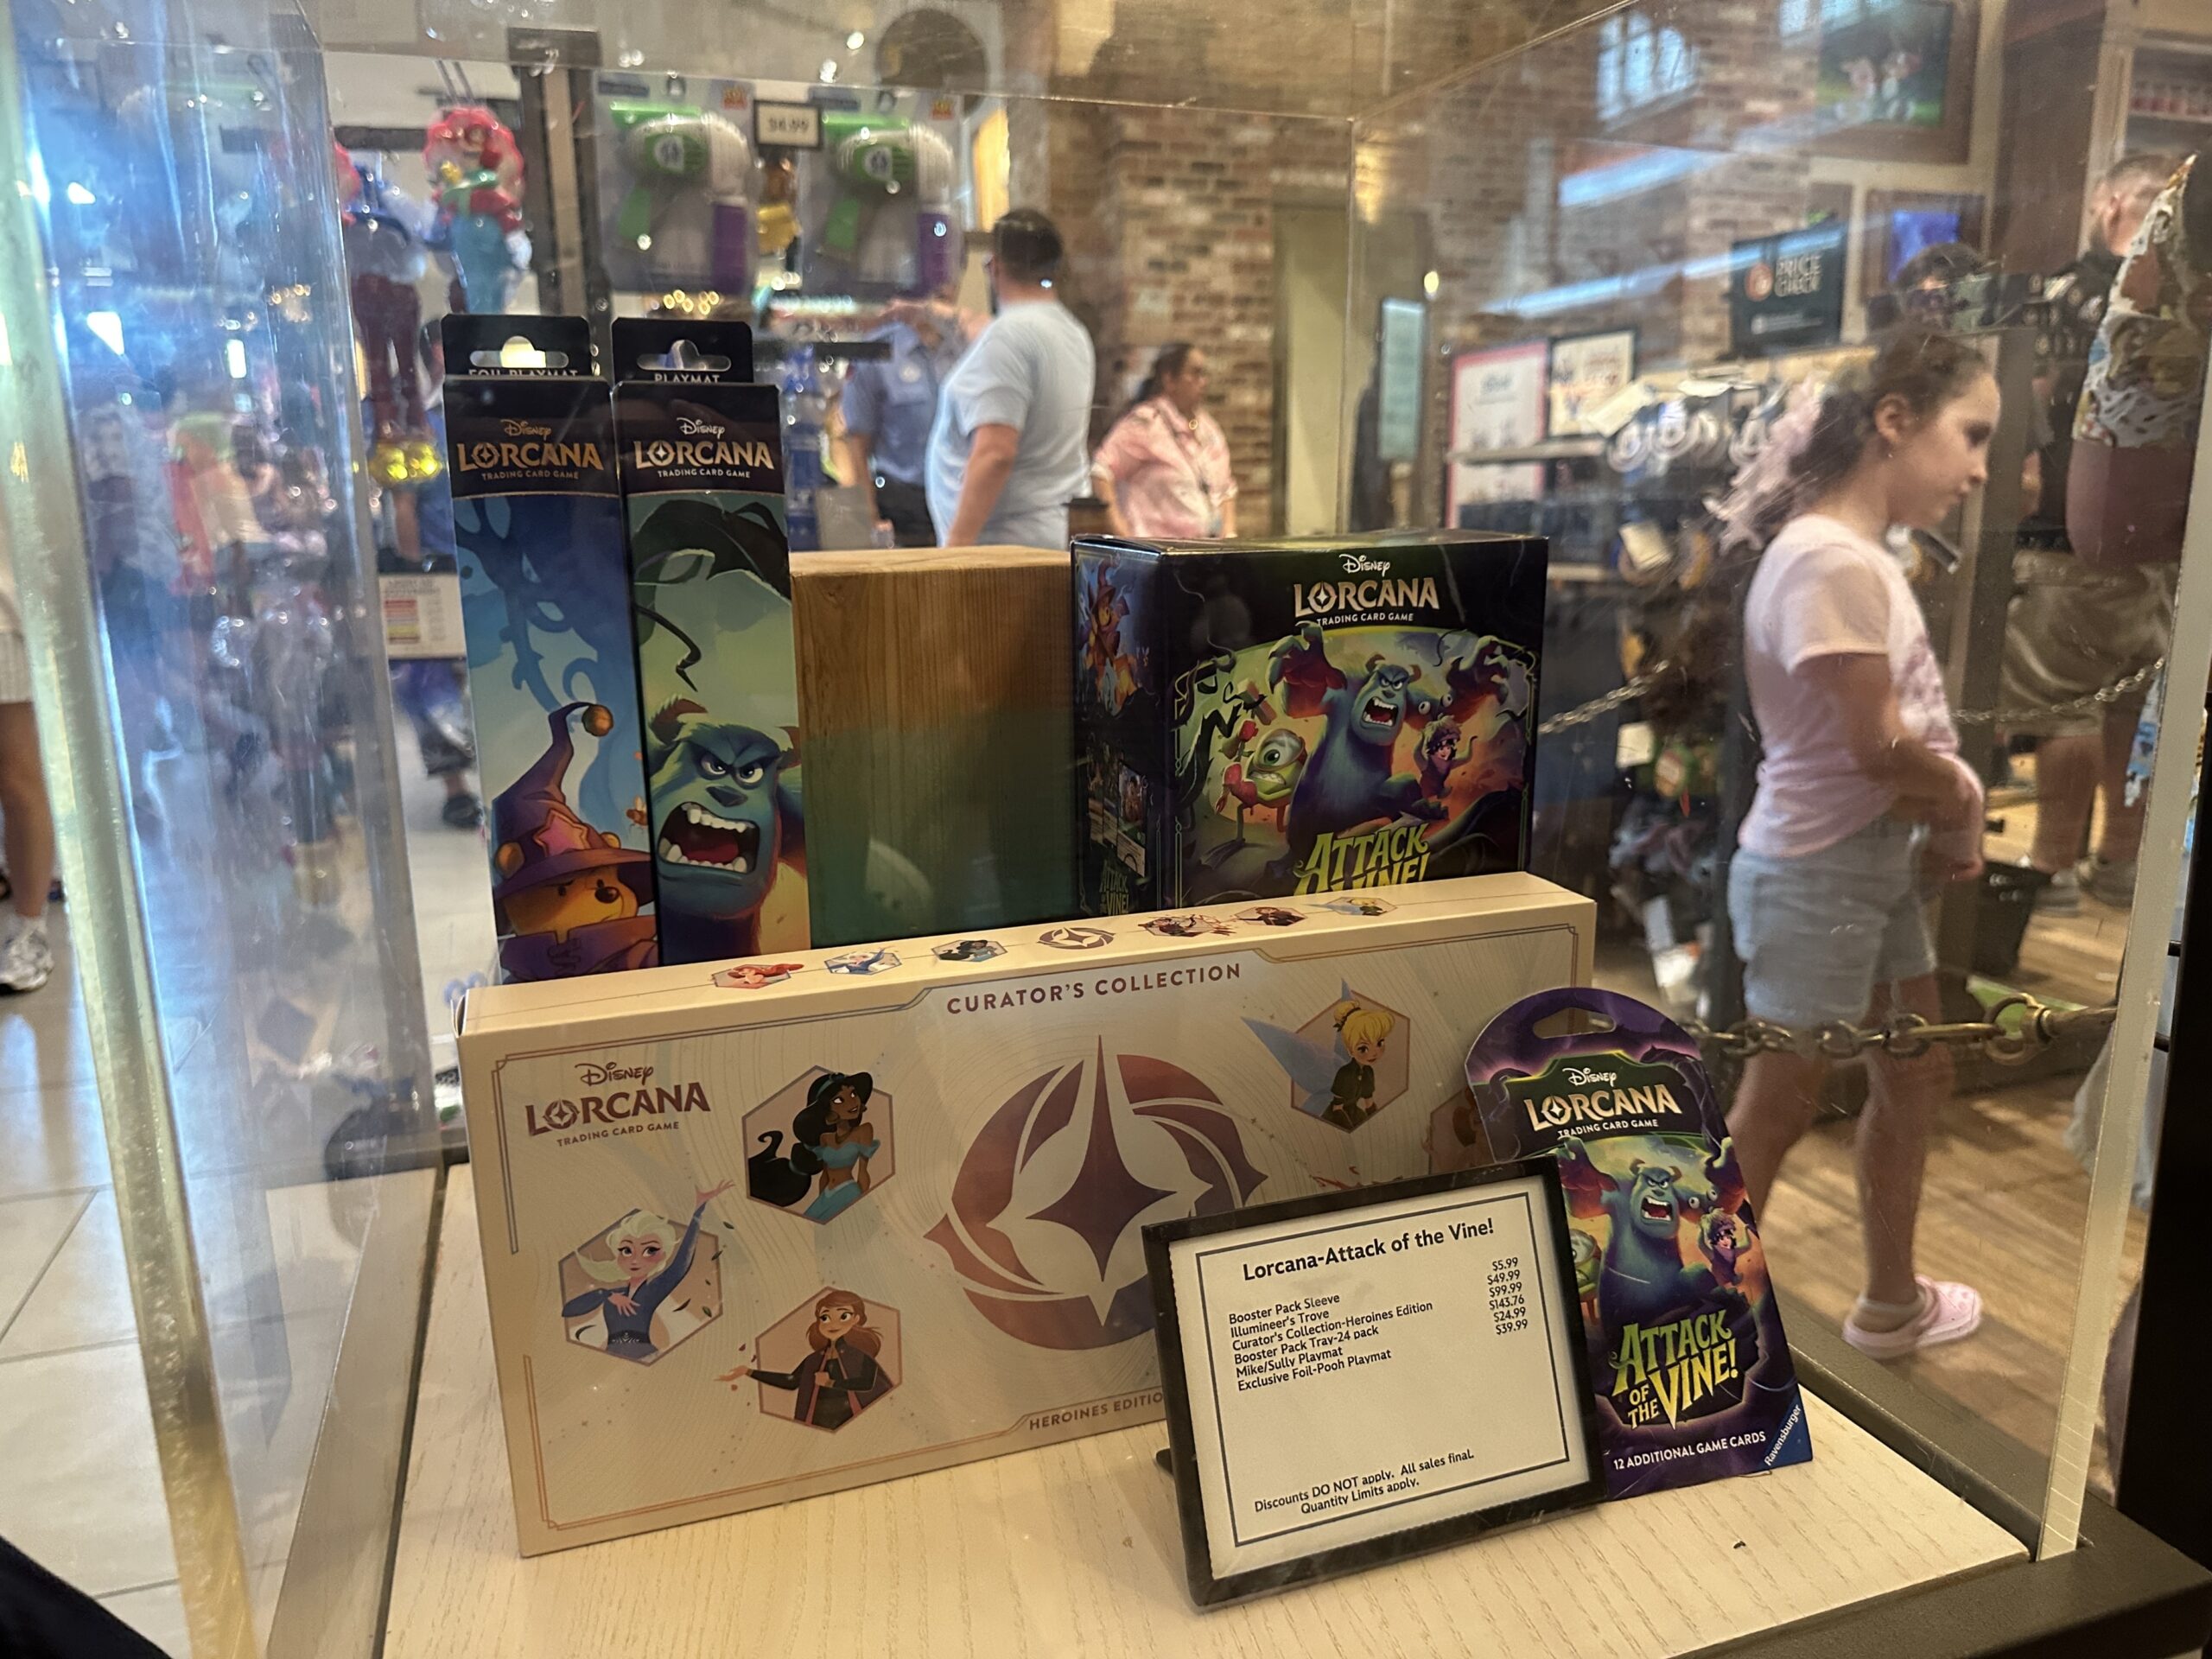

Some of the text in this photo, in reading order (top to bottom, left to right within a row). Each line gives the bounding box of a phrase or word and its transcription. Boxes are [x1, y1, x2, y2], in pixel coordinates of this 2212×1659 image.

[654, 373, 720, 383] PLAYMAT
[500, 418, 552, 441] Disney
[677, 417, 725, 439] Disney
[456, 442, 604, 472] LORCANA
[633, 441, 774, 470] LORCANA
[482, 470, 523, 481] TRADING
[553, 470, 579, 480] GAME
[658, 468, 750, 478] TRADING CARD GAME
[1339, 554, 1391, 576] Disney
[1294, 577, 1440, 618] LORCANA
[1317, 612, 1414, 626] TRADING CARD GAME
[1293, 823, 1430, 896] ATTACK
[946, 963, 1241, 1015] CURATOR'S COLLECTION
[574, 1062, 654, 1086] Disney
[1562, 1067, 1618, 1087] Disney
[525, 1082, 711, 1137] LORCANA
[1523, 1084, 1682, 1132] LORCANA
[556, 1122, 679, 1147] TRADING CARD GAME
[1557, 1119, 1659, 1138] TRADING CARD GAME
[1243, 1217, 1494, 1281] Lorcana-Attack of the Vine!
[1487, 1269, 1521, 1285] $49.99
[1491, 1257, 1518, 1271] $5.99
[1489, 1281, 1522, 1298] $99.99
[1489, 1294, 1525, 1311] $143.76
[1229, 1294, 1340, 1325] Booster Pack Sleeve
[1230, 1310, 1330, 1338] Illumineer's Trove
[1493, 1306, 1526, 1322] $24.99
[1232, 1301, 1433, 1351] Curator's Collection-Heroines Edition
[1496, 1319, 1528, 1335] $39.99
[1234, 1325, 1379, 1364] Booster Pack Tray-24 pack
[1609, 1309, 1732, 1397] ATTACK
[1236, 1346, 1343, 1377] Mike/Sully Playmat
[1237, 1349, 1392, 1391] Exclusive Foil-Pooh Playmat
[1629, 1384, 1649, 1406] OF
[1647, 1338, 1738, 1431] VINE!
[1030, 1391, 1164, 1431] HEROINES EDITIO
[1627, 1398, 1660, 1430] THE
[1764, 1404, 1802, 1467] Ravensburger
[1613, 1431, 1766, 1470] 12 ADDITIONAL GAME CARDS
[1254, 1449, 1474, 1512] Discounts DO NOT apply. All sales final.
[1300, 1477, 1420, 1514] Quantity Limits apply.
